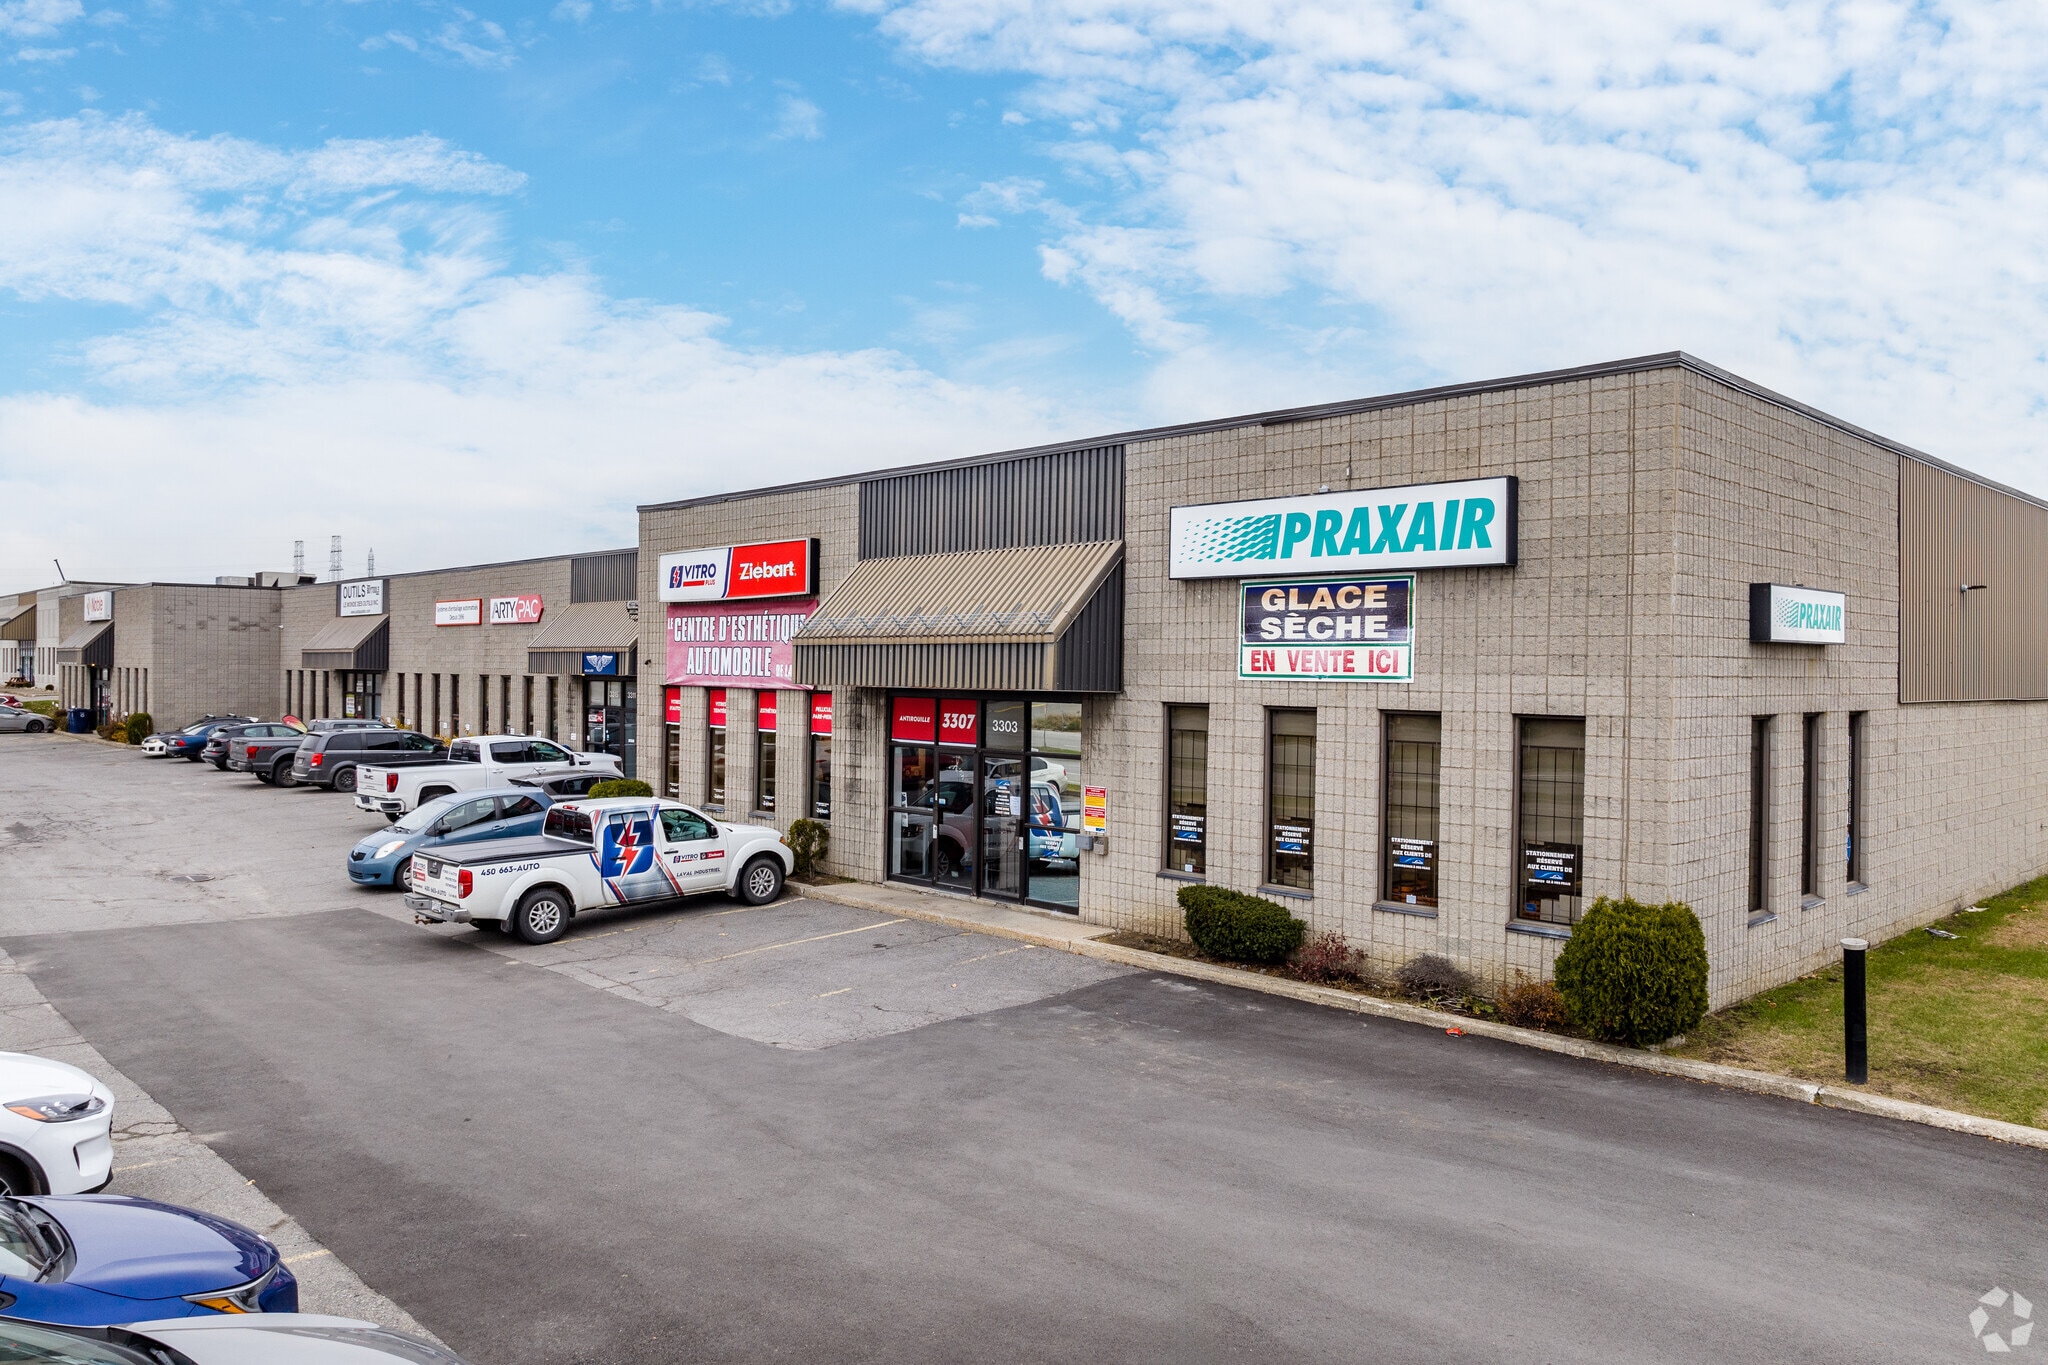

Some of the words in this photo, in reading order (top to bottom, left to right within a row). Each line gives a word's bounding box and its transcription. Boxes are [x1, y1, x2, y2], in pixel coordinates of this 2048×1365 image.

[1281, 497, 1495, 559] PRAXAIR
[685, 563, 716, 580] VITRO
[739, 561, 795, 580] Ziebart
[343, 584, 366, 599] OUTILS
[1261, 585, 1387, 611] GLACE
[1800, 603, 1841, 631] PRAXAIR
[668, 618, 673, 630] LE
[674, 616, 716, 642] CENTRE
[1260, 613, 1388, 640] SÈCHE
[686, 646, 772, 677] AUTOMOBILE
[1251, 650, 1275, 673] EN
[1288, 650, 1355, 673] VENTE
[1368, 649, 1399, 673] ICI
[899, 715, 931, 723] ANTIROUILLE
[942, 713, 976, 730] 3307
[992, 719, 1018, 733] 3303
[1391, 837, 1433, 846] STATIONNEMENT
[1526, 850, 1574, 859] STATIONNEMENT
[1537, 857, 1563, 865] RÉSERVÉ
[480, 868, 496, 876] 450
[499, 863, 540, 874] 663-AUTO
[694, 867, 720, 875] INDUSTRIEL
